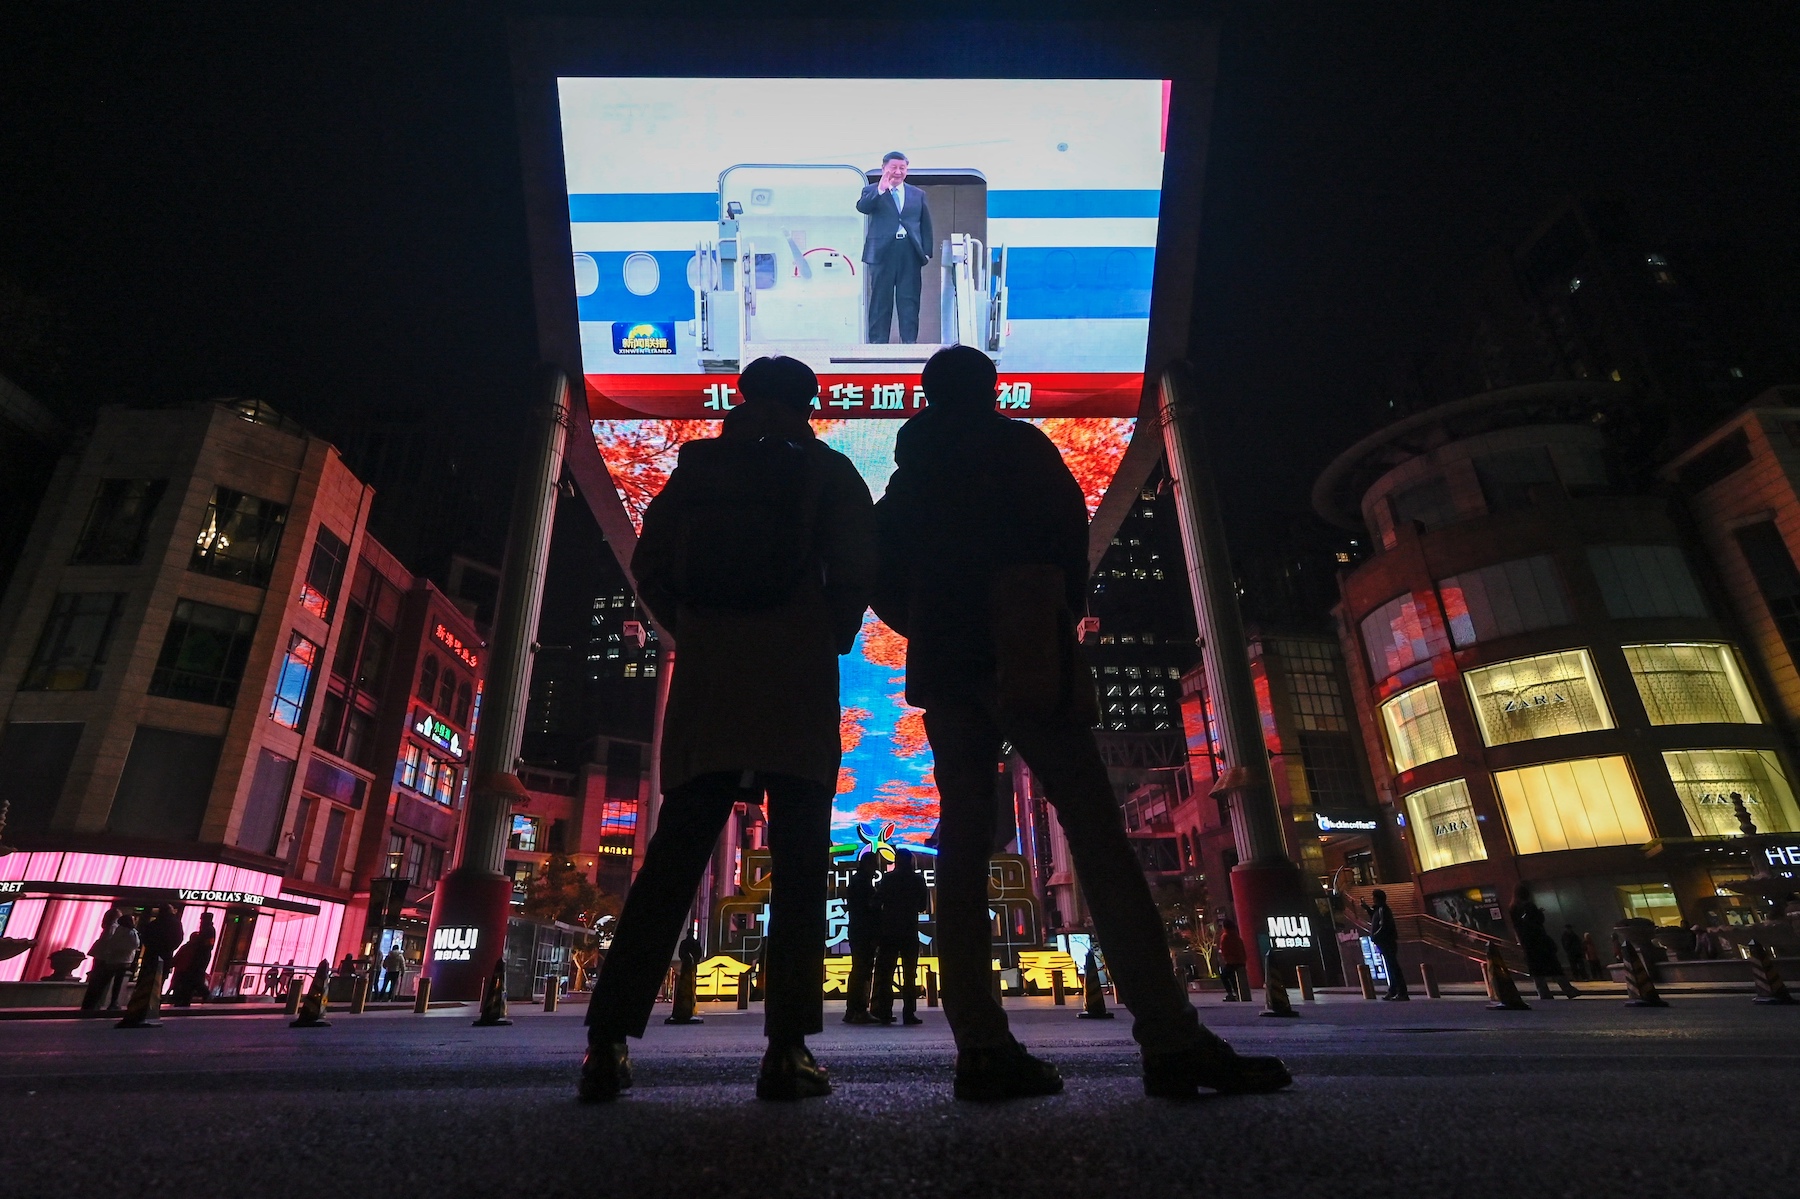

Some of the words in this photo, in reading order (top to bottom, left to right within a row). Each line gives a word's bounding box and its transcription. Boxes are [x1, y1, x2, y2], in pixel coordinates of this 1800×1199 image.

[622, 338, 667, 348] 新闻联播
[1504, 693, 1565, 713] ZARA
[1698, 794, 1759, 805] ZAA
[1434, 820, 1469, 837] ZARA
[178, 889, 241, 902] VICTORIA'S
[243, 893, 265, 905] SECRET
[1266, 916, 1311, 937] MUJI
[433, 928, 479, 950] MUJI
